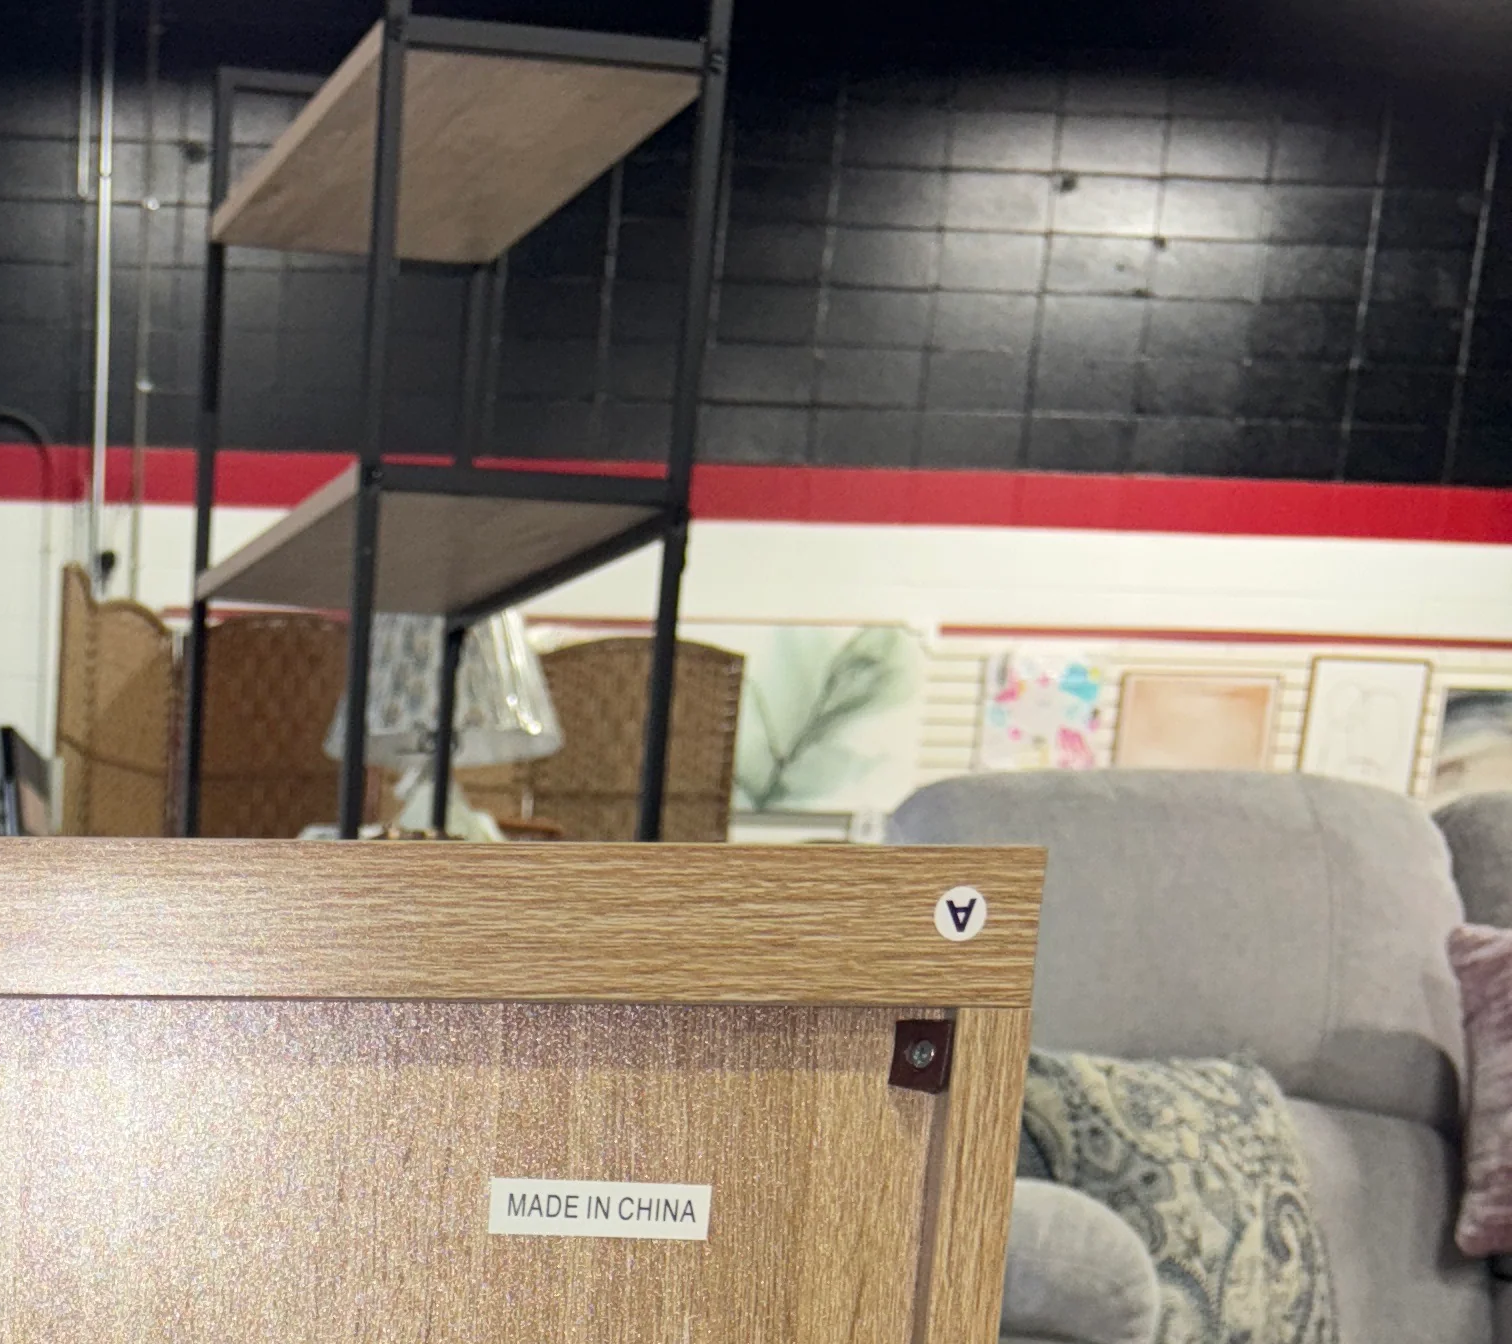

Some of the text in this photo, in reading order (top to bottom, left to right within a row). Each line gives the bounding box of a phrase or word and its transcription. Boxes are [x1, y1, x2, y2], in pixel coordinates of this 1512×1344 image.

[945, 897, 977, 933] A
[506, 1192, 696, 1223] MADE IN CHINA
